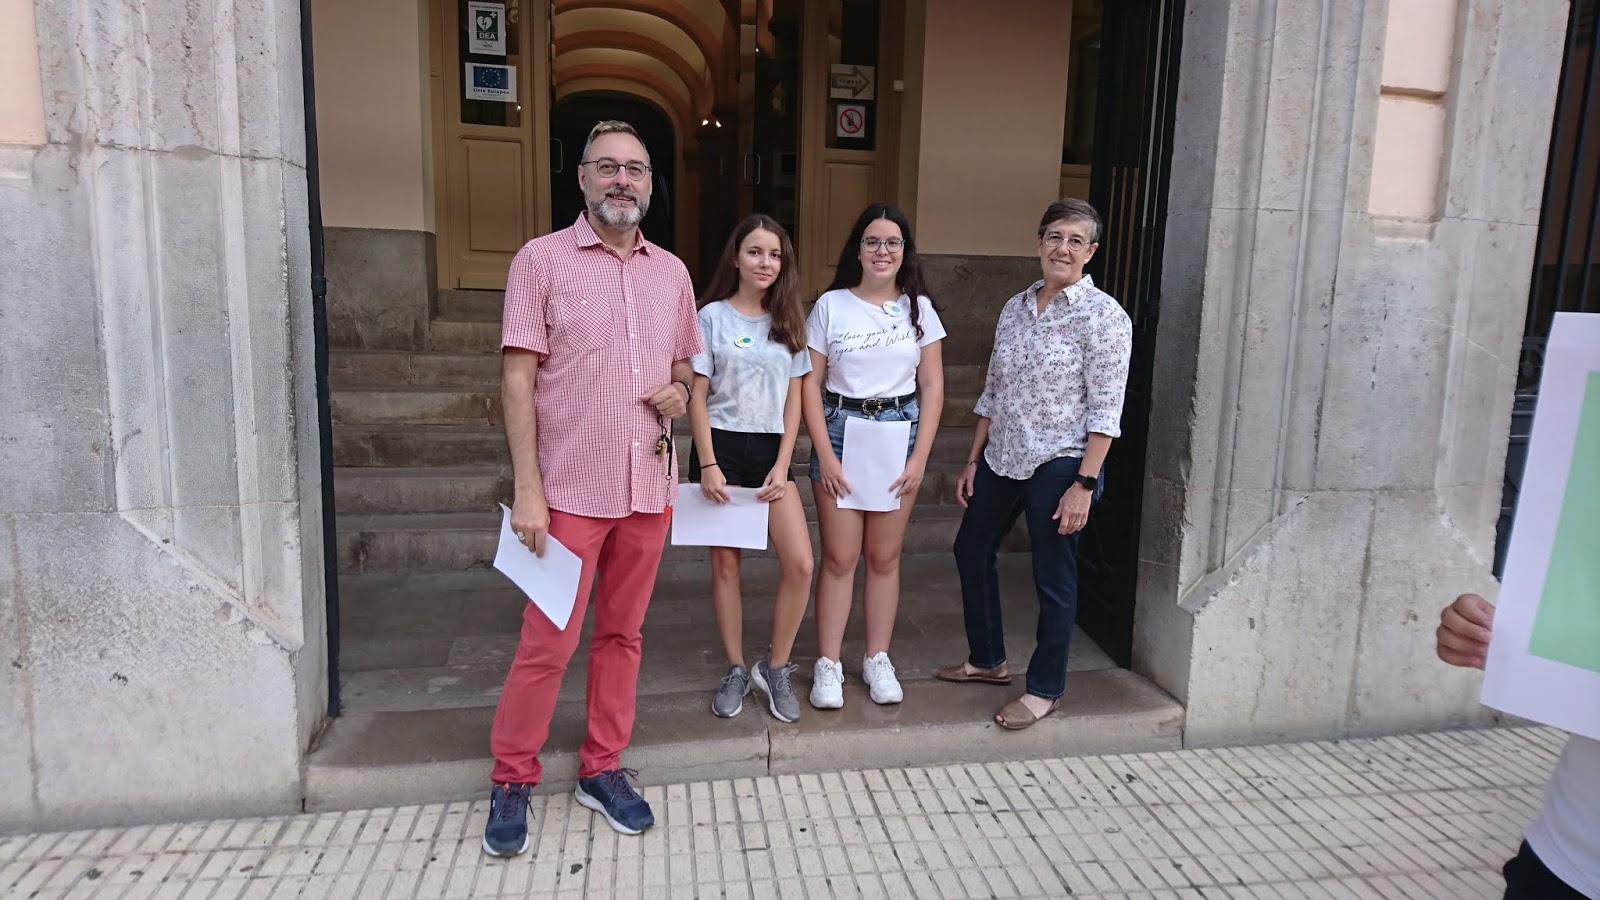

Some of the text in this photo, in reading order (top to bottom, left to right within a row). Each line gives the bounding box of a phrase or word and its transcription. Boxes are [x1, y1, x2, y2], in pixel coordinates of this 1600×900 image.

[480, 32, 496, 40] DEA
[835, 346, 856, 361] eyes
[860, 338, 881, 350] and
